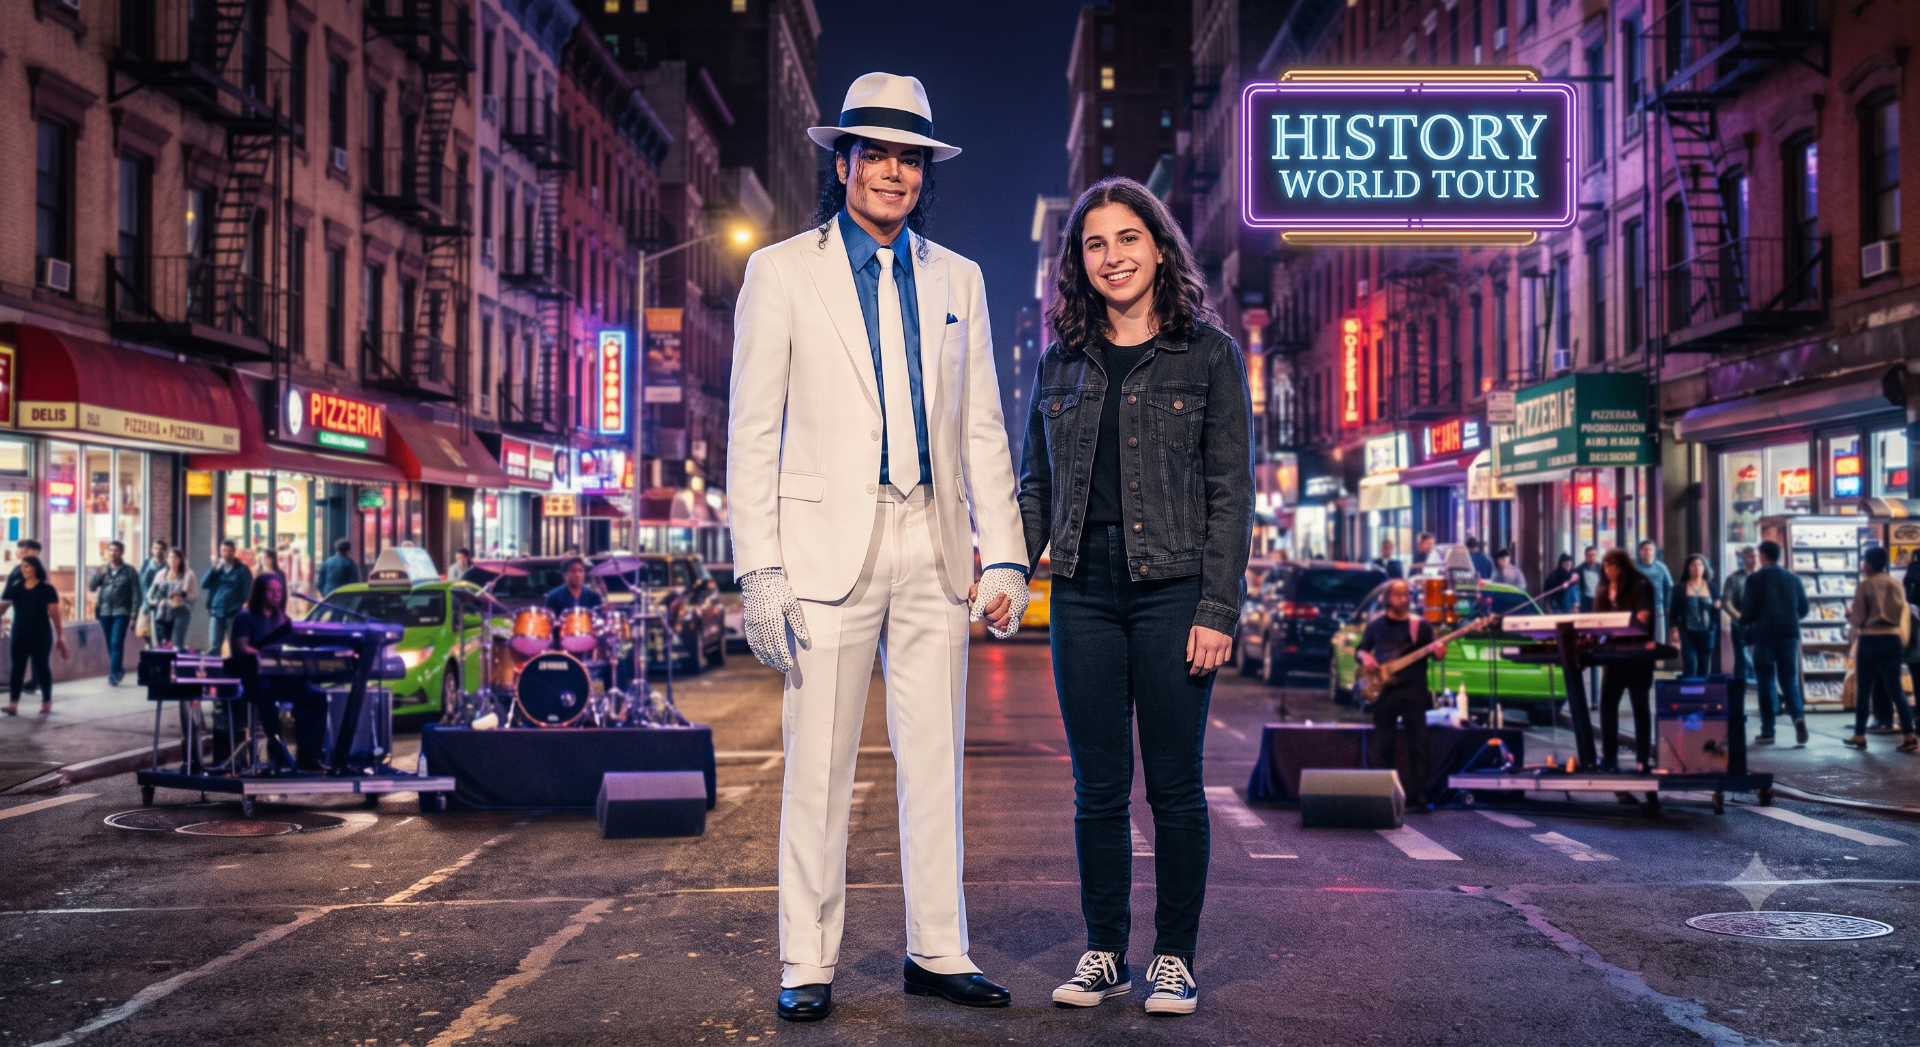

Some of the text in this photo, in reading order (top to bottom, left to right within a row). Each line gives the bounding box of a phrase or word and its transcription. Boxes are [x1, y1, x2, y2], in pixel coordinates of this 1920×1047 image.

[1271, 113, 1548, 161] HISTORY
[1278, 169, 1540, 199] WORLD TOUR
[31, 407, 67, 422] DELIS
[124, 416, 161, 436] PIZZERIA
[169, 424, 205, 443] PIZZERIA
[310, 391, 383, 439] PIZZERIA
